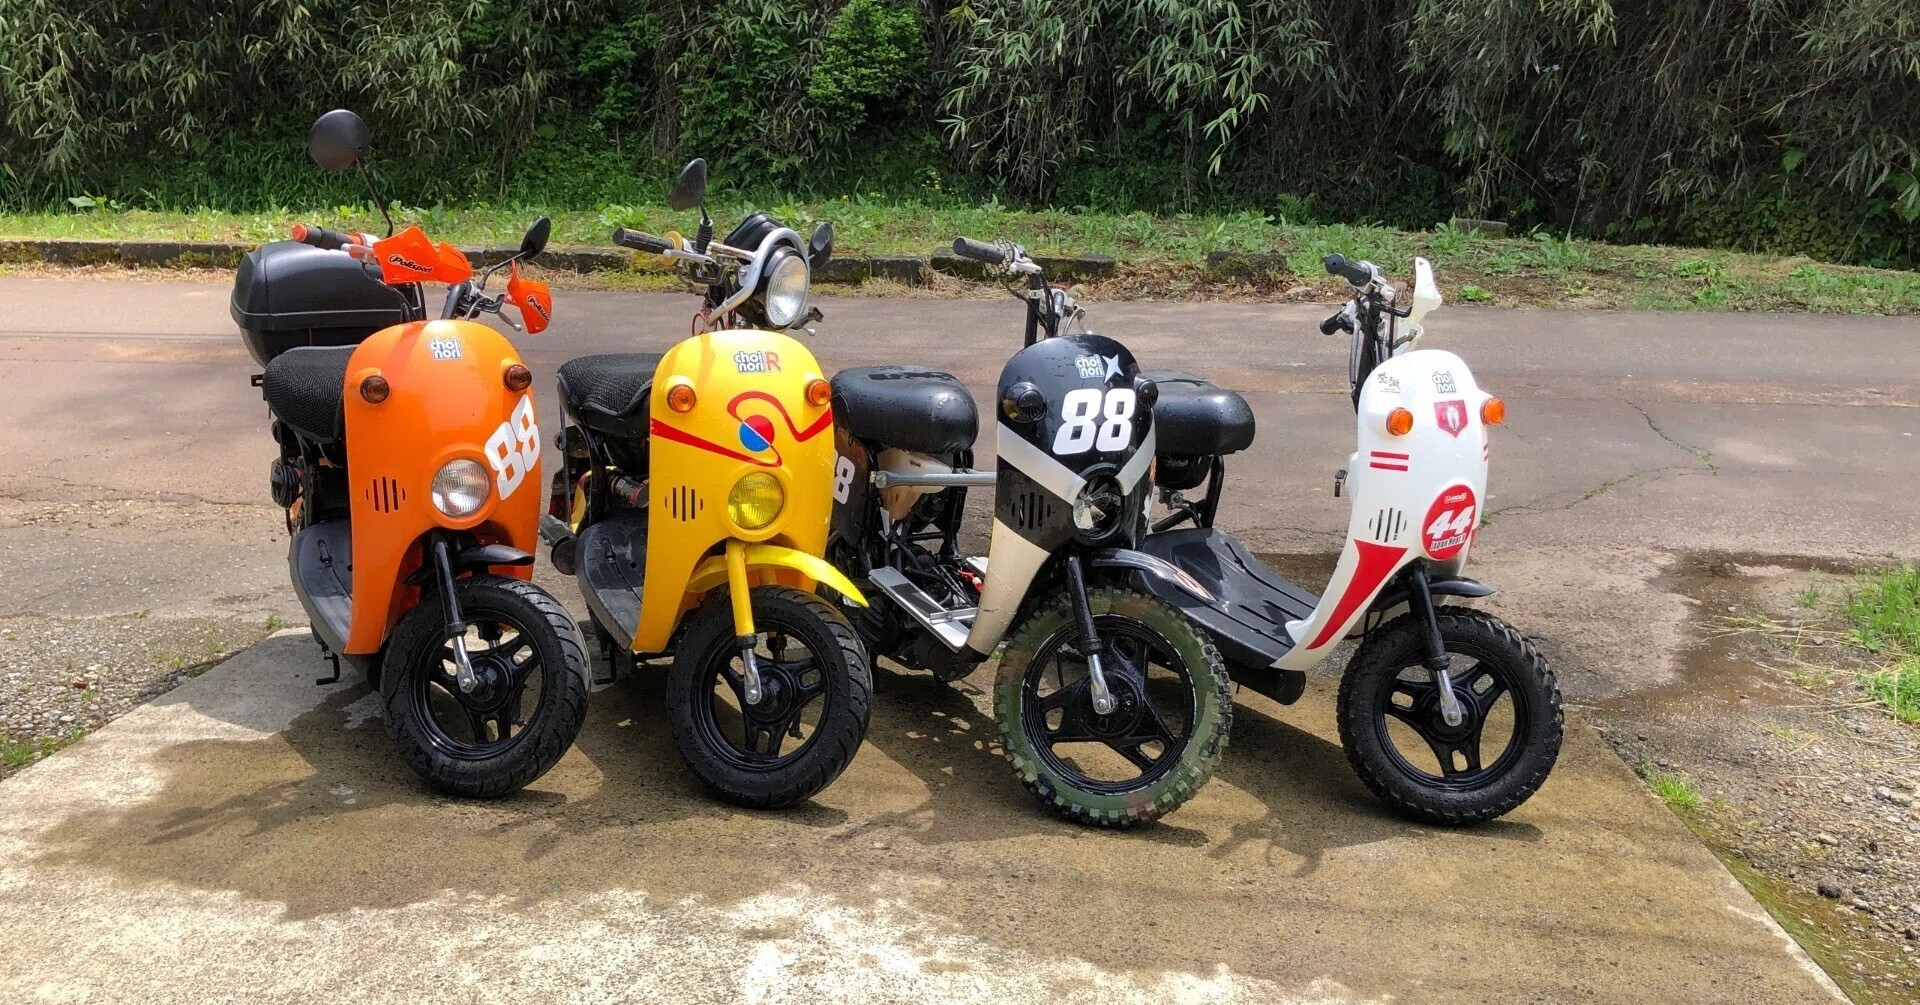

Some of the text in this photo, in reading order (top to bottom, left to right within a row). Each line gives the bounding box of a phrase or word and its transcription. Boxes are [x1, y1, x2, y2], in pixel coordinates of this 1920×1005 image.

[389, 255, 433, 273] Polisport
[527, 295, 550, 322] Polispor
[429, 338, 459, 350] choi
[734, 351, 762, 362] choi
[1075, 354, 1101, 367] choi
[738, 361, 764, 372] nori
[1080, 366, 1104, 378] nori
[1432, 370, 1453, 383] choi
[1437, 381, 1457, 393] nori
[1052, 388, 1136, 455] 88
[484, 394, 540, 500] 88
[834, 449, 855, 504] 8
[1426, 505, 1474, 539] 44
